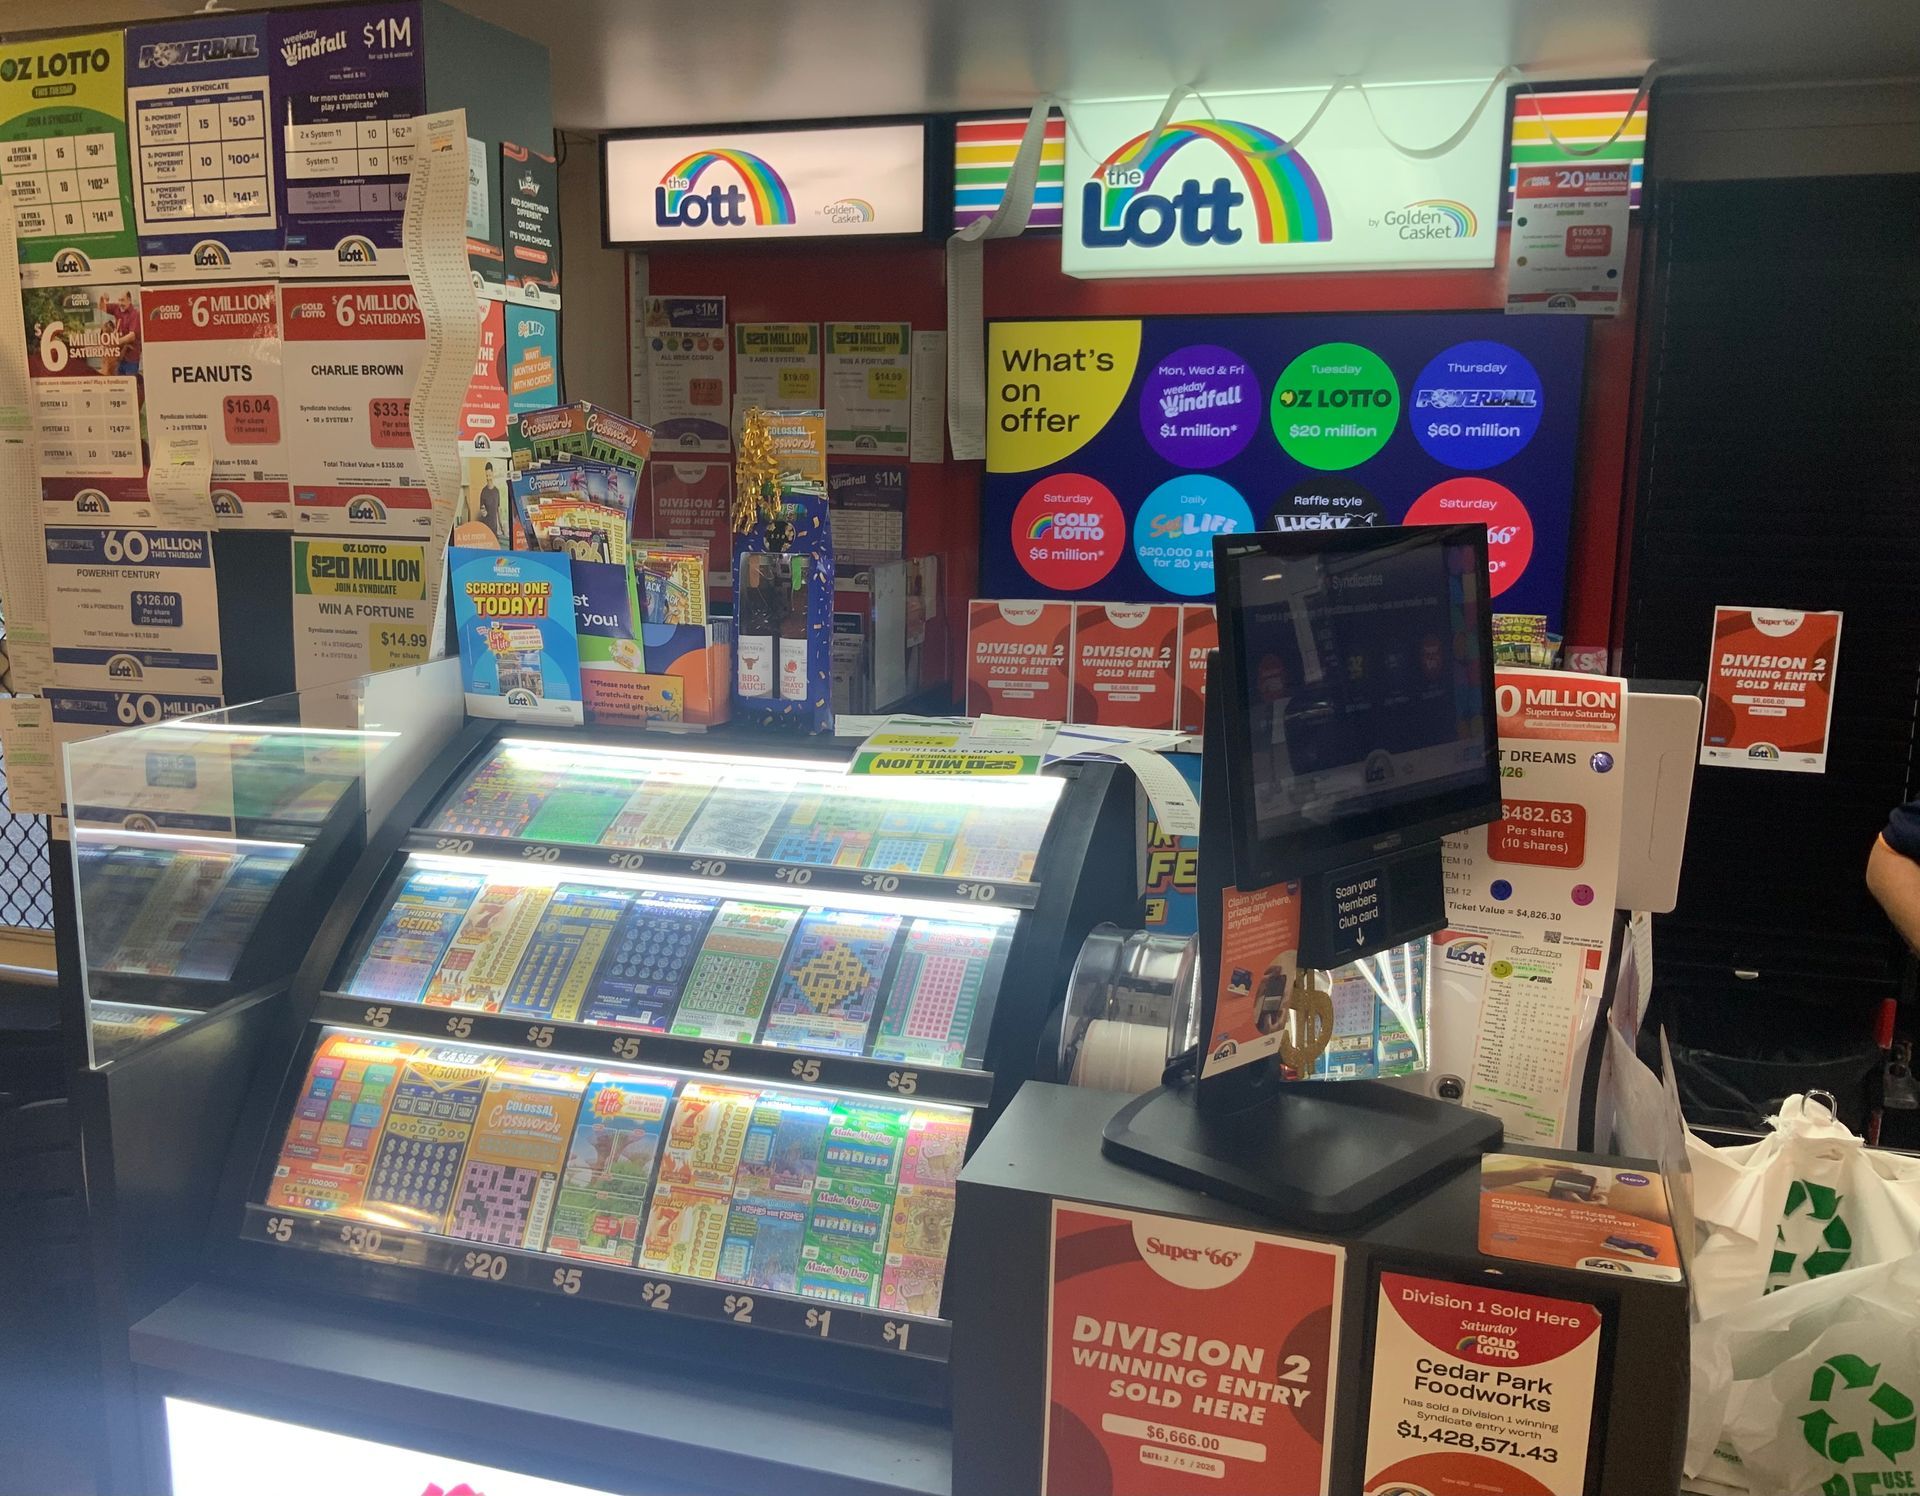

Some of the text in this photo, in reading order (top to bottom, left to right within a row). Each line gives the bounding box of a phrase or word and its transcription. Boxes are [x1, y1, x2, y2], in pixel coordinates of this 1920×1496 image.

[199, 119, 209, 129] 15
[368, 129, 377, 139] 10
[201, 157, 212, 167] 10
[368, 157, 378, 167] 10
[668, 177, 688, 189] the
[1106, 167, 1142, 185] the
[203, 194, 214, 205] 10
[655, 185, 746, 228] Lott
[831, 213, 861, 224] Casket
[1082, 177, 1244, 248] Lott
[1368, 210, 1442, 228] by Golden
[1399, 224, 1452, 240] Casket
[159, 305, 180, 313] GOLD
[301, 303, 323, 311] GOLD
[301, 310, 326, 319] LOTTO
[160, 311, 183, 320] LOTTO
[213, 312, 270, 325] SATURDAYS
[359, 312, 420, 325] SATURDAYS
[69, 347, 121, 358] SATURDAYS
[1001, 347, 1115, 373] What's
[171, 364, 253, 383] PEANUTS
[311, 364, 403, 376] CHARLIE BROWN
[1159, 364, 1245, 377] Mon, Wed & Fri
[1311, 363, 1363, 377] Tuesday
[1447, 361, 1507, 375] Thursday
[1001, 383, 1041, 402] on
[227, 399, 271, 414] $16.04
[1000, 407, 1080, 434] offer
[1289, 423, 1377, 440] $20 million
[1427, 422, 1520, 439] $60 million
[77, 501, 98, 512] Lott
[1043, 493, 1094, 506] Saturday
[1181, 495, 1207, 506] Daily
[1294, 496, 1363, 508] Raffle style
[1439, 499, 1498, 511] Saturday
[349, 507, 373, 520] Lott
[101, 530, 202, 562] $60 MILLION
[343, 543, 387, 554] OZ LOTTO
[168, 551, 202, 559] THURSDAY
[1153, 558, 1190, 569] for 20
[77, 569, 160, 579] POWERHIT CENTURY
[466, 582, 550, 595] SCRATCH ONE
[136, 594, 176, 606] $126.00
[474, 596, 545, 616] TODAY!
[319, 603, 414, 619] WIN A FORTUNE
[381, 631, 427, 647] $14.99
[976, 642, 1064, 656] DIVISION 2
[1082, 645, 1171, 658] DIVISION 2
[976, 655, 1064, 667] WINNING ENTRY
[1082, 658, 1171, 669] WINNING ENTRY
[1721, 653, 1827, 670] DIVISION 2
[109, 666, 131, 677] Lott
[990, 666, 1048, 676] SOLD HERE
[1096, 669, 1155, 679] SOLD HERE
[1720, 668, 1826, 682] WINNING ENTRY
[1736, 680, 1806, 692] SOLD HERE
[508, 695, 528, 706] Lott
[1525, 688, 1617, 709] MILLION
[1525, 707, 1617, 722] Superdraw Saturday
[1510, 750, 1577, 765] DREAMS
[1748, 748, 1769, 759] Lott
[875, 757, 1018, 771] $20 MILLION
[1506, 825, 1565, 839] Per share
[436, 837, 475, 855] $20
[1501, 837, 1569, 855] (10 shares)
[522, 846, 561, 863] $20
[608, 853, 644, 869] $10
[690, 860, 727, 876] $10
[775, 867, 812, 884] $10
[861, 873, 899, 892] $10
[1335, 877, 1378, 900] Scan your
[956, 883, 995, 901] $10
[1338, 893, 1378, 914] Members
[408, 910, 444, 919] HIDDEN
[1339, 906, 1379, 929] Club card
[1446, 946, 1486, 966] Lott
[364, 1007, 392, 1028] $5
[446, 1017, 474, 1039] $5
[527, 1026, 555, 1048] $5
[612, 1037, 641, 1059] $5
[702, 1049, 732, 1072] $5
[791, 1058, 821, 1082] $5
[887, 1071, 918, 1095] $5
[1620, 1175, 1648, 1186] New
[267, 1217, 294, 1242] $5
[340, 1224, 382, 1252] $30
[464, 1251, 507, 1281] $20
[553, 1266, 583, 1295] $5
[642, 1281, 671, 1311] $2
[724, 1295, 754, 1324] $2
[1402, 1288, 1581, 1329] Division 1 Sold Here
[805, 1307, 831, 1337] $1
[1460, 1319, 1517, 1337] Saturday
[883, 1321, 909, 1351] $1
[1477, 1334, 1516, 1350] GOLD
[1072, 1315, 1312, 1383] DIVISION 2
[1476, 1344, 1520, 1361] LOTTO
[1072, 1346, 1312, 1409] WINNING ENTRY
[1416, 1357, 1553, 1395] Cedar Park
[1108, 1379, 1267, 1426] SOLD HERE
[1414, 1375, 1552, 1414] Foodworks
[1402, 1396, 1560, 1434] has sold a Division 1 winning
[1416, 1410, 1542, 1440] Syndicate entry worth
[1146, 1424, 1220, 1451] $6,666.00
[1396, 1419, 1559, 1464] $1,428,571.43
